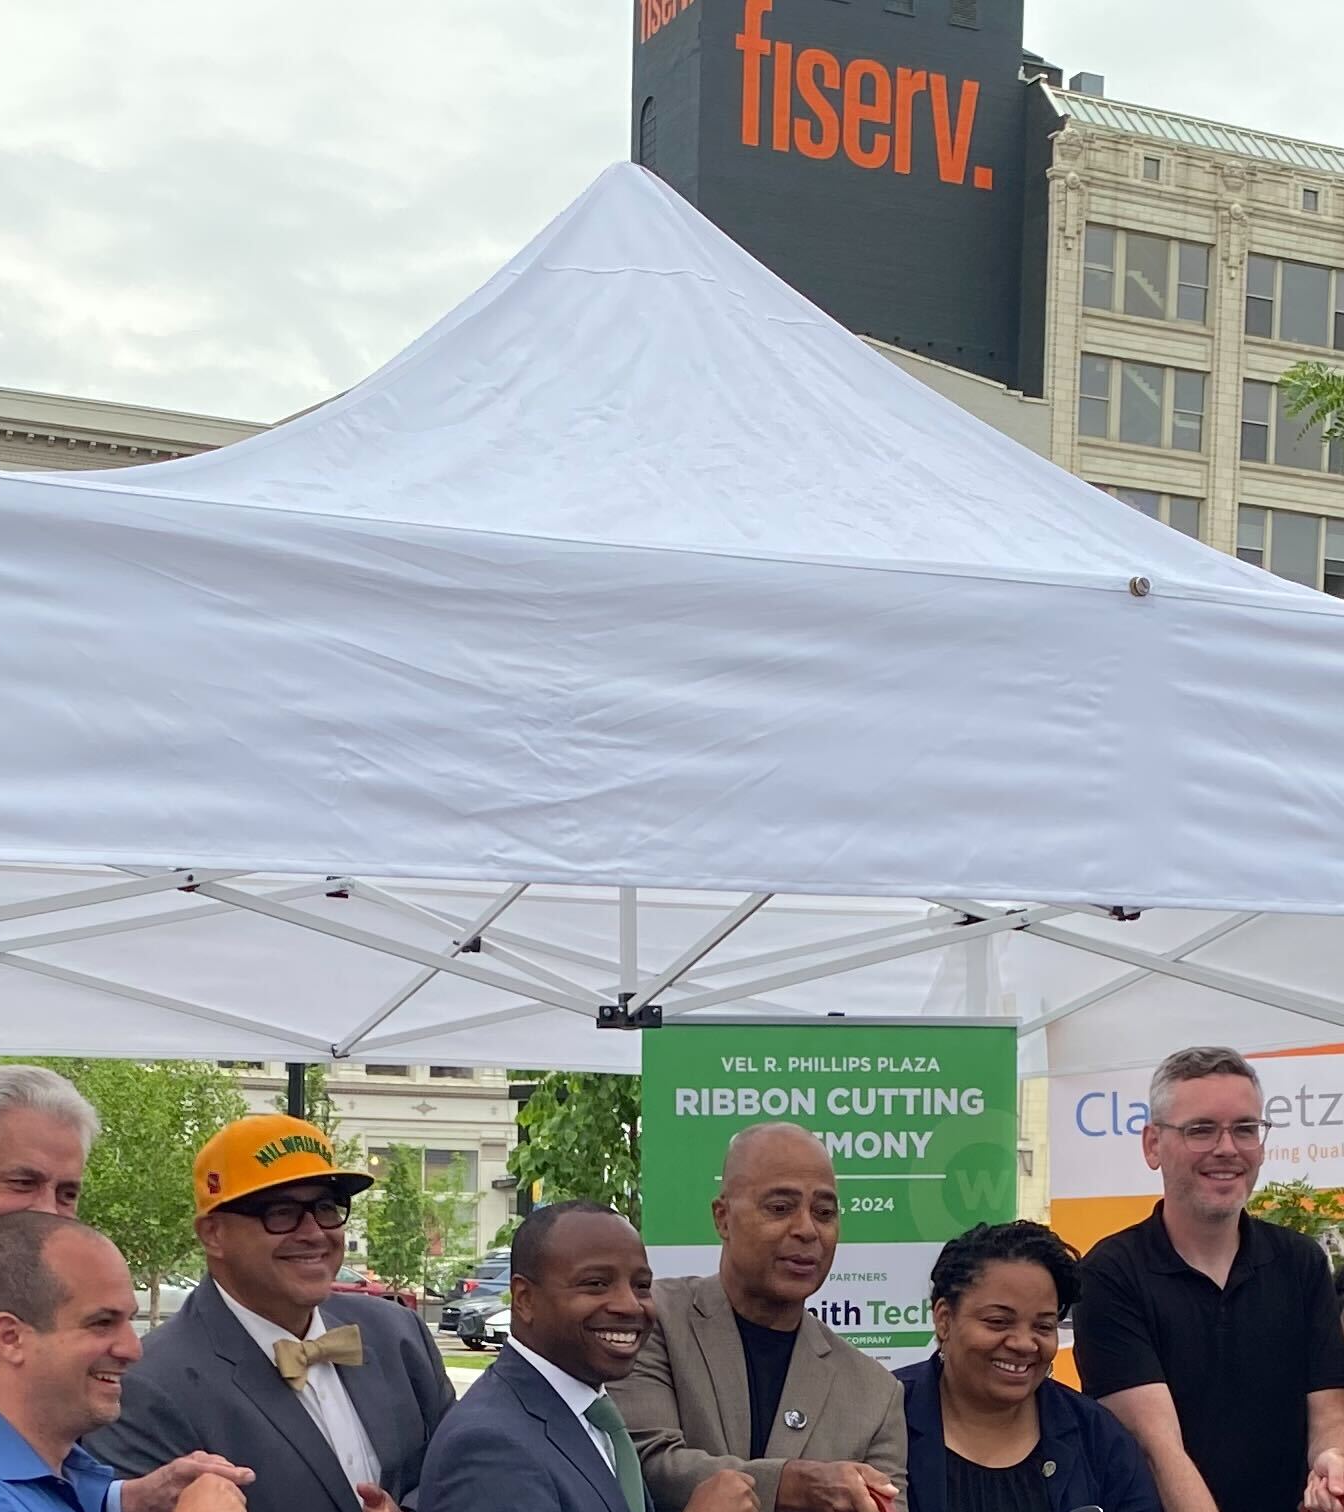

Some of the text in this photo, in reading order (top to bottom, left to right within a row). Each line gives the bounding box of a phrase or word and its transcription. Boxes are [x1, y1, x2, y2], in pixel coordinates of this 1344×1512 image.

[735, 0, 993, 190] fiserv.
[721, 1056, 941, 1073] VEL R. PHILLIPS PLAZA
[675, 1087, 985, 1116] RIBBON CUTTING
[1076, 1084, 1344, 1137] Cla etz
[729, 1130, 933, 1159] MONY
[850, 1197, 895, 1213] 2024
[829, 1272, 888, 1283] PARTNERS
[806, 1301, 861, 1326] ith
[846, 1335, 892, 1346] COMPANY
